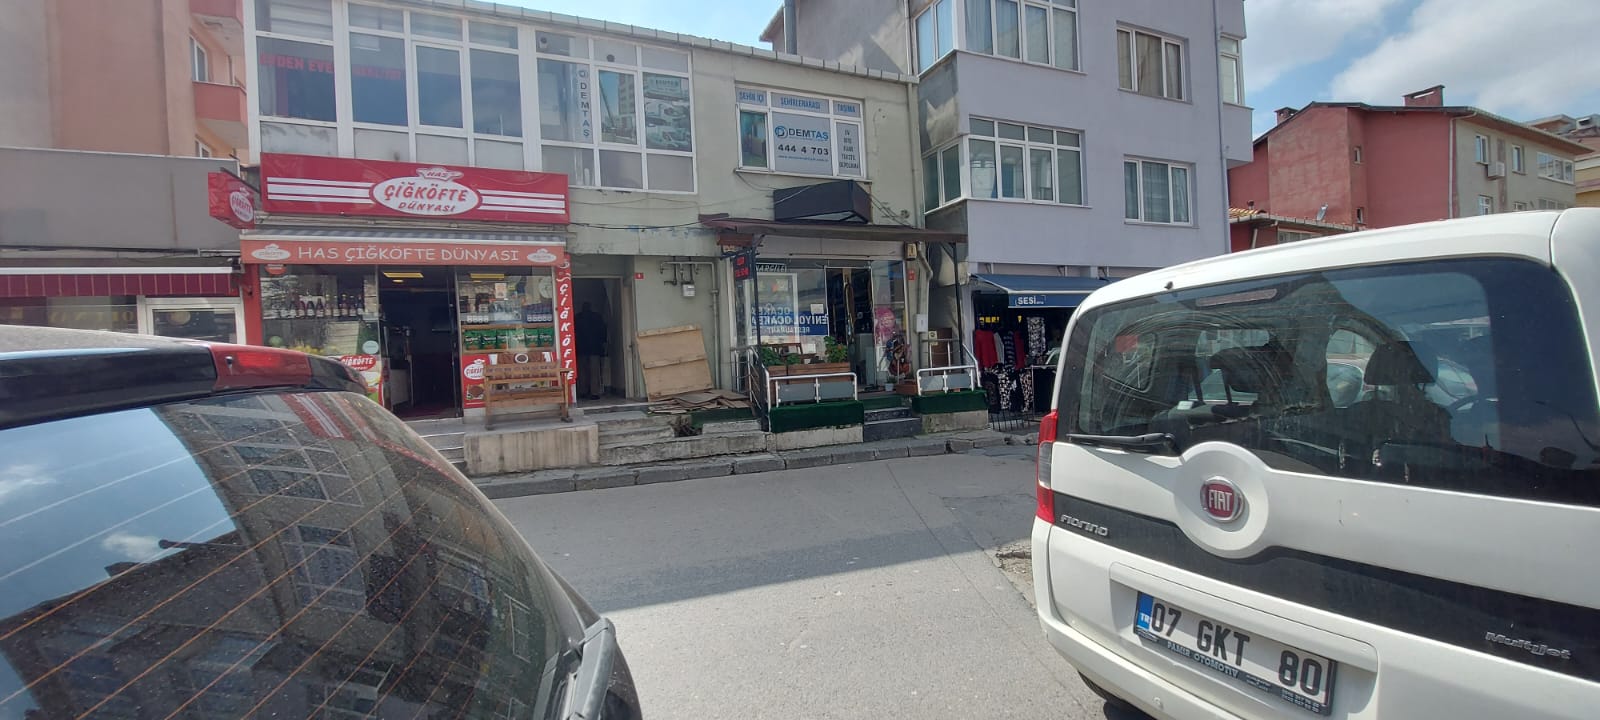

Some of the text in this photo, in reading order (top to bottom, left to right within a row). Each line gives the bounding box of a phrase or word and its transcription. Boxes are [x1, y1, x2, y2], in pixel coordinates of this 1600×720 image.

[778, 144, 829, 155] 444 4 703
[384, 182, 468, 202] ÇİĞKÖFTE
[398, 201, 456, 212] DÜNYASI
[298, 247, 339, 259] HAS
[344, 245, 435, 261] ÇİĞKÖFTE
[441, 248, 519, 261] DÜNYASI
[559, 282, 574, 380] ÇİĞKÖFTE
[1209, 489, 1233, 512] FIAT
[1139, 612, 1150, 623] TR
[1151, 602, 1182, 637] 07
[1196, 620, 1250, 667] GKT
[1279, 650, 1323, 696] 80
